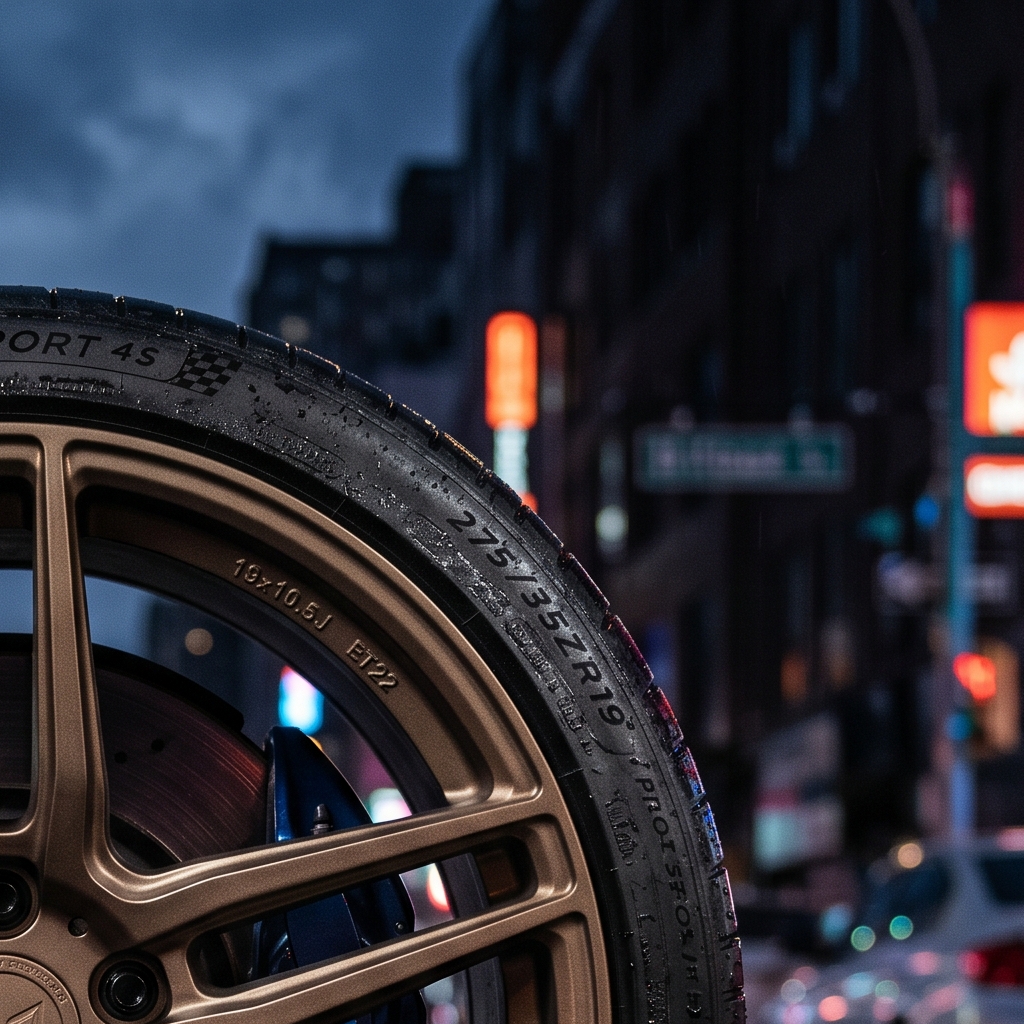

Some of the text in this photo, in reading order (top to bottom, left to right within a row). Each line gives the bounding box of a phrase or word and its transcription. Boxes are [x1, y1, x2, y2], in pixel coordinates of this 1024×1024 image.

[110, 342, 161, 367] 4S
[232, 557, 400, 694] 19x10.5J ET22
[445, 510, 627, 727] 275/35ZR19
